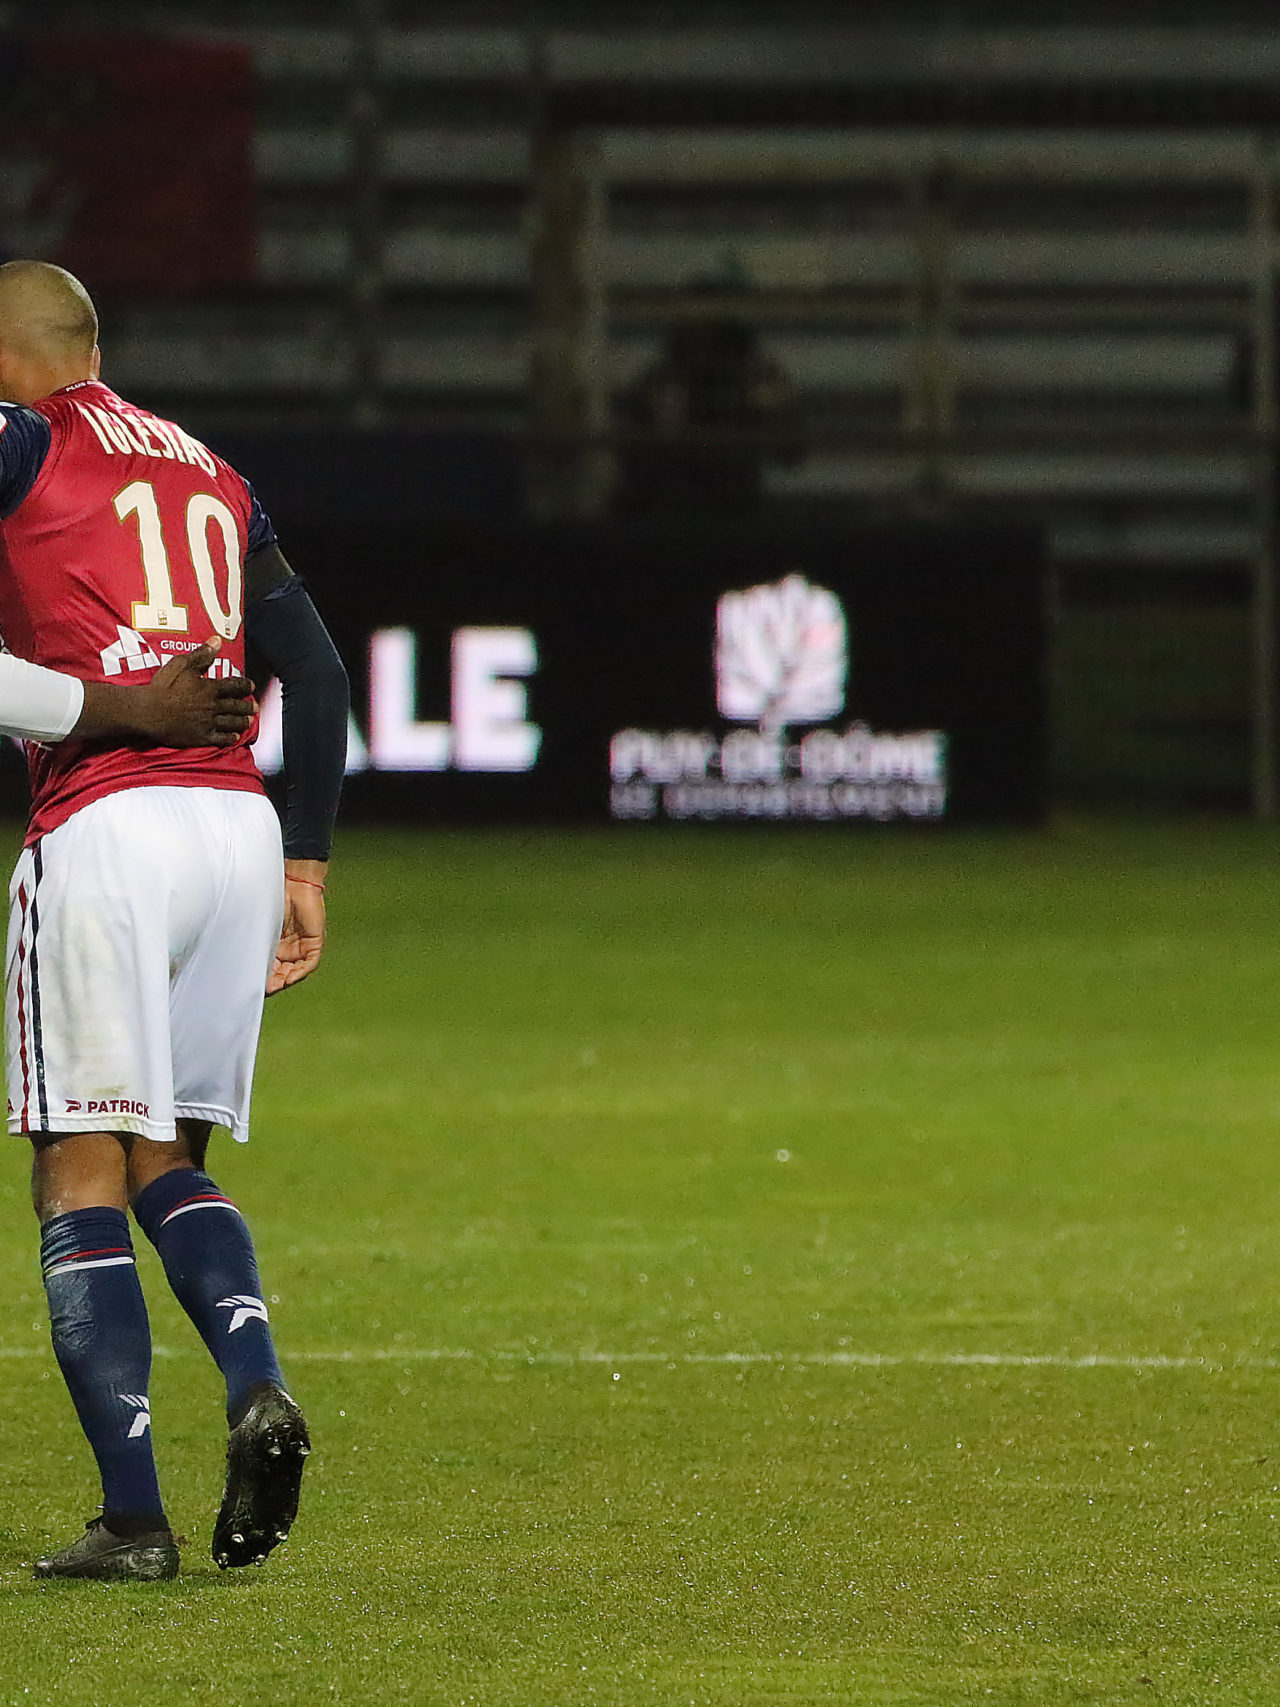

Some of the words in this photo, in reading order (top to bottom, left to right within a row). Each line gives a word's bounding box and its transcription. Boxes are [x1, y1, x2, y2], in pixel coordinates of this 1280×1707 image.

[78, 404, 218, 477] IGLESIAS
[113, 481, 243, 641] 10
[87, 1099, 150, 1119] PATRICK
